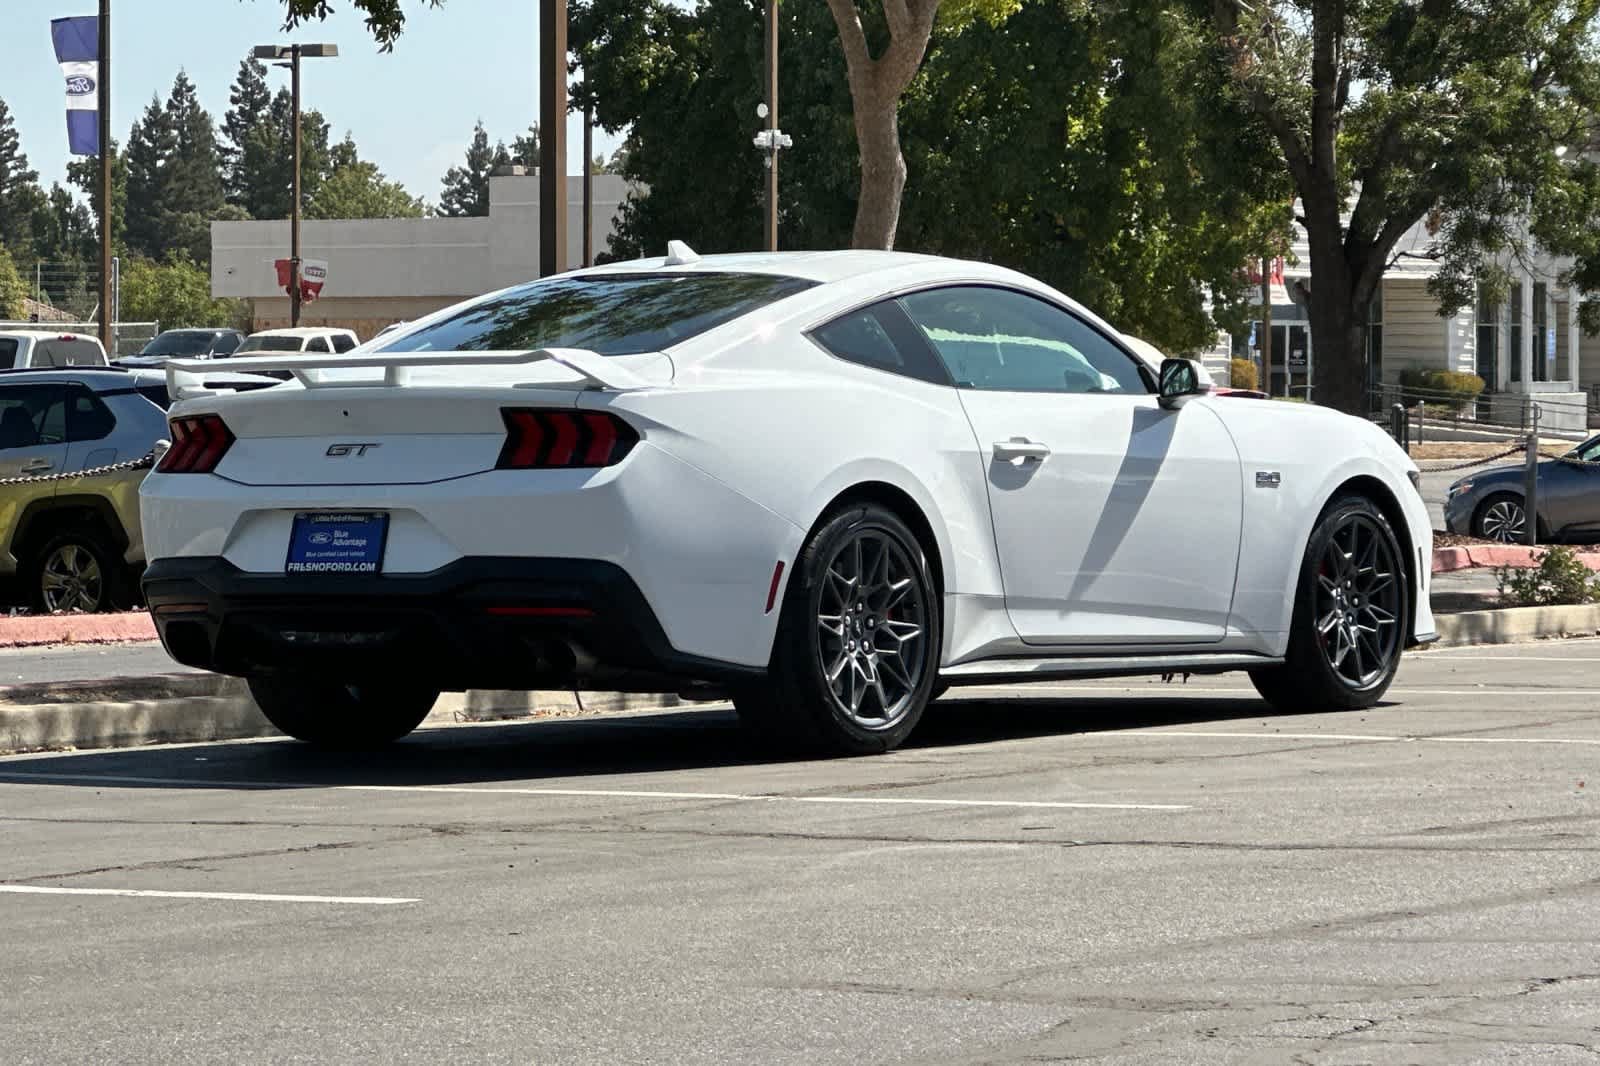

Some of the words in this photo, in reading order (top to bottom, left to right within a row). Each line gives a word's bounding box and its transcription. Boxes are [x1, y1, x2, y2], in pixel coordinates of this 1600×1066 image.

[326, 443, 380, 456] GT
[332, 538, 367, 546] Advantage
[287, 562, 376, 572] FRESNOFORD.COM
